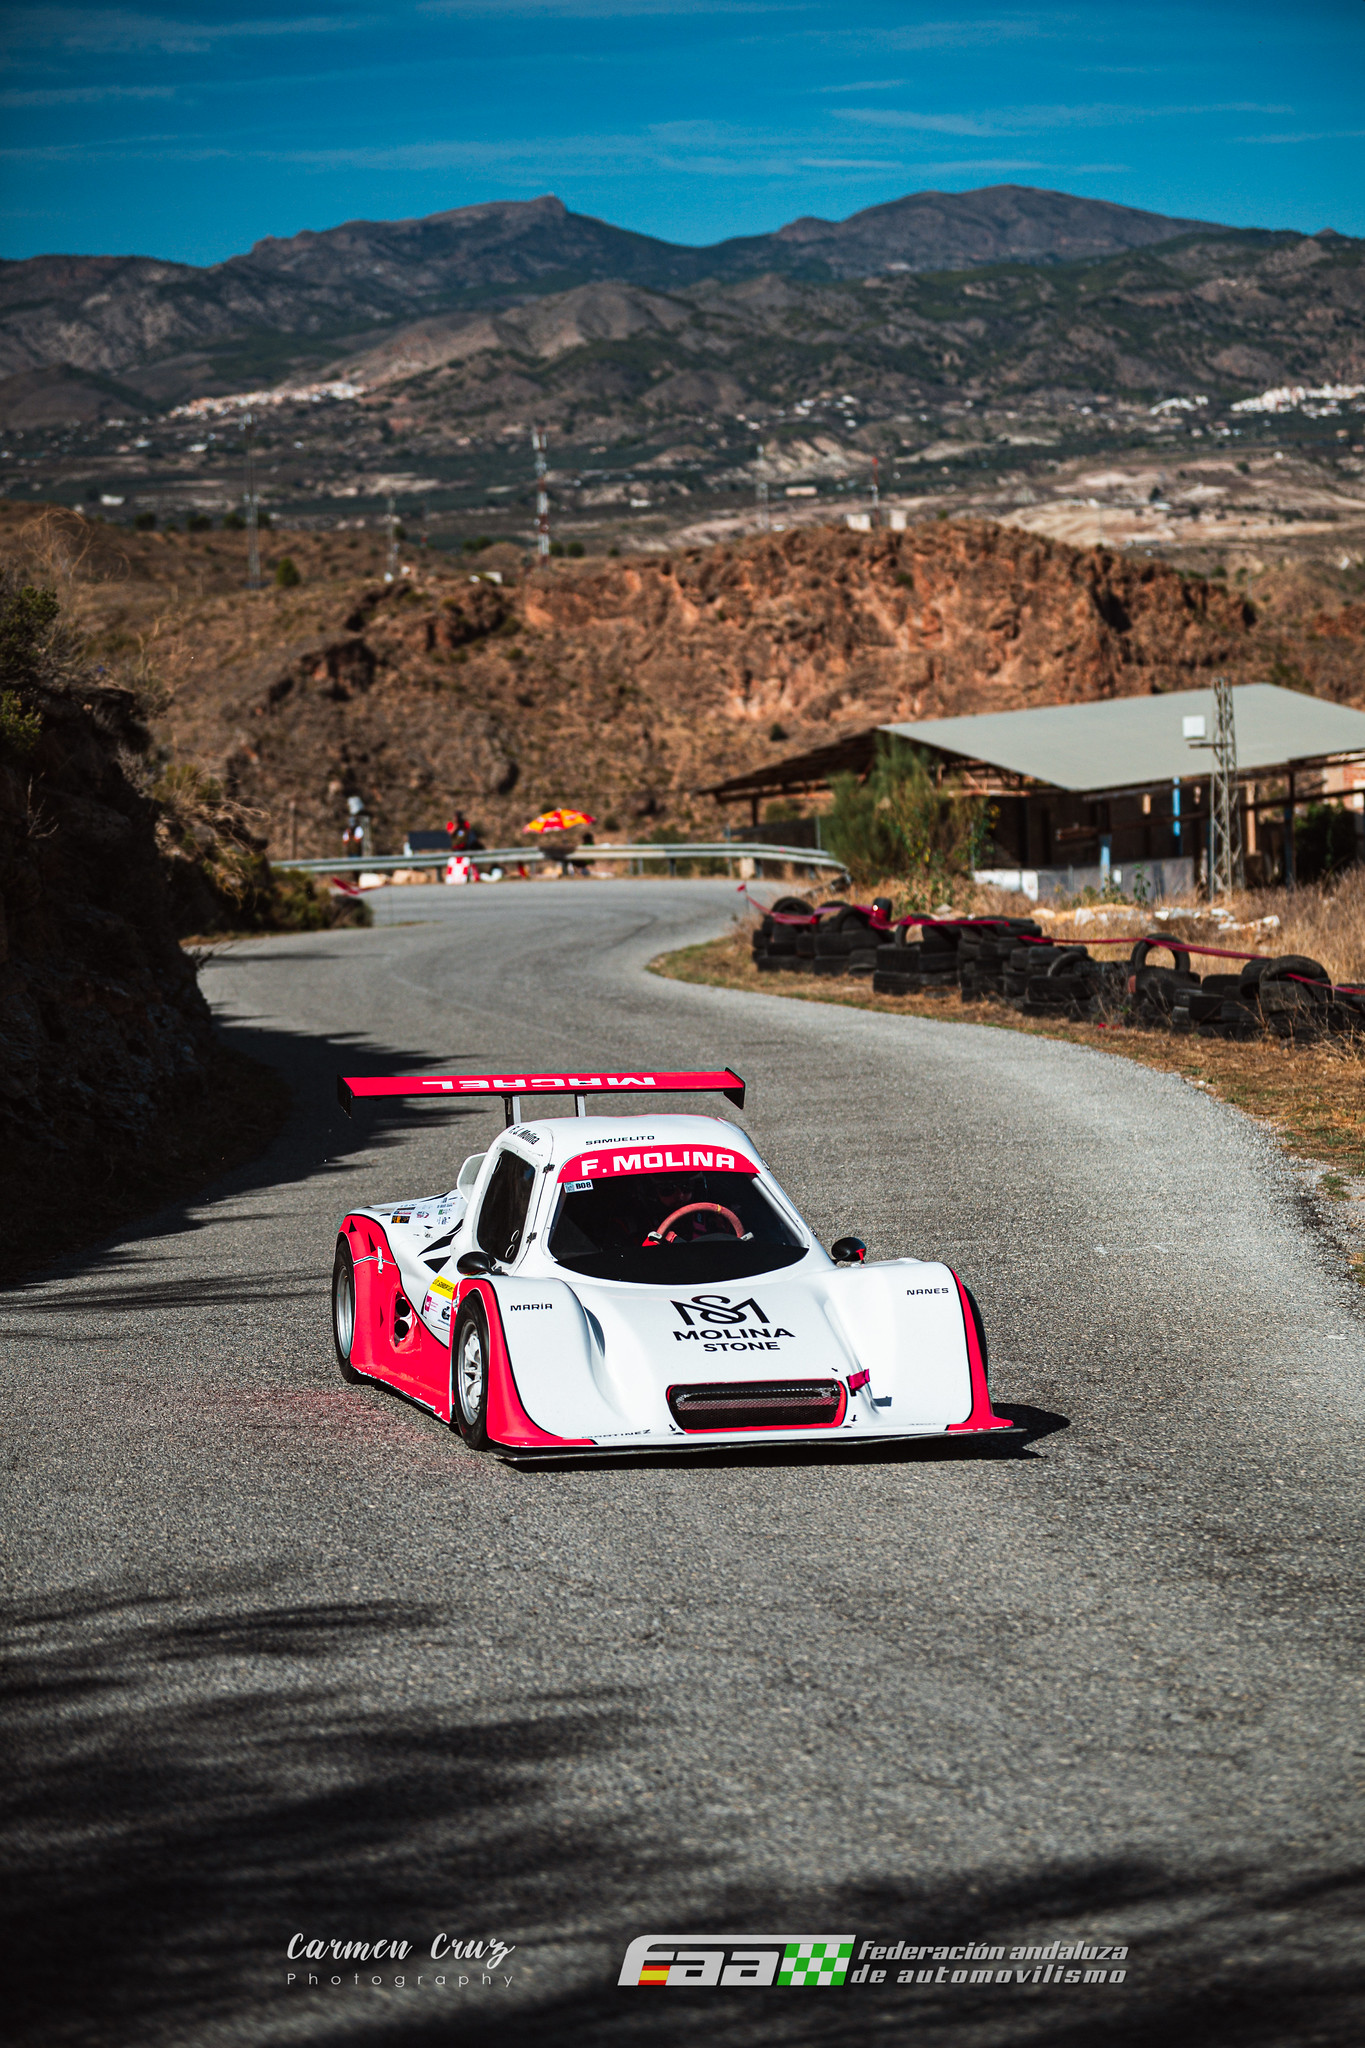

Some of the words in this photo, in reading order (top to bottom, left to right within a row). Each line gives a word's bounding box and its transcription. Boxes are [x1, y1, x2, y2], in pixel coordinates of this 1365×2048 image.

[422, 1076, 656, 1090] MACAEL
[585, 1135, 655, 1145] SAMUELITO
[906, 1287, 949, 1296] NANES
[672, 1327, 796, 1342] MOLINA
[703, 1341, 781, 1352] STONE
